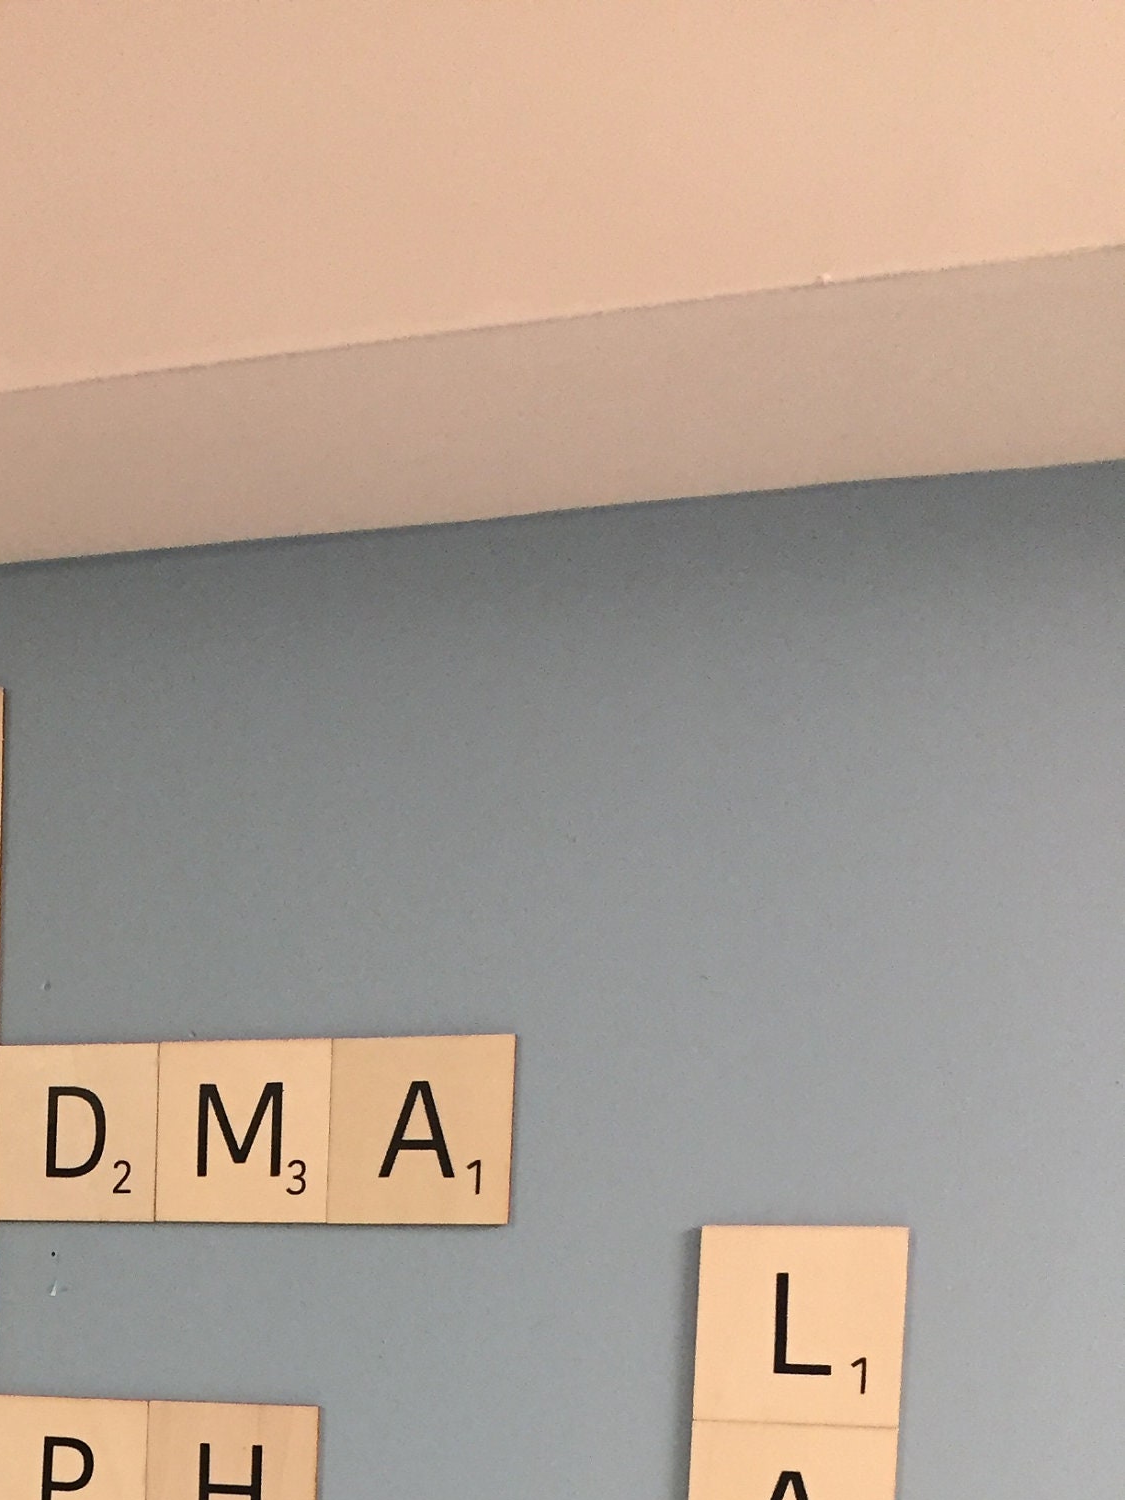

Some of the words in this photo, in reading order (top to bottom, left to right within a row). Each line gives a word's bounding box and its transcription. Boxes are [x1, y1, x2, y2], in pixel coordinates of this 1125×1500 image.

[111, 1158, 133, 1195] 2
[284, 1158, 308, 1197] 3
[465, 1158, 483, 1196] 1
[849, 1356, 868, 1396] 1
